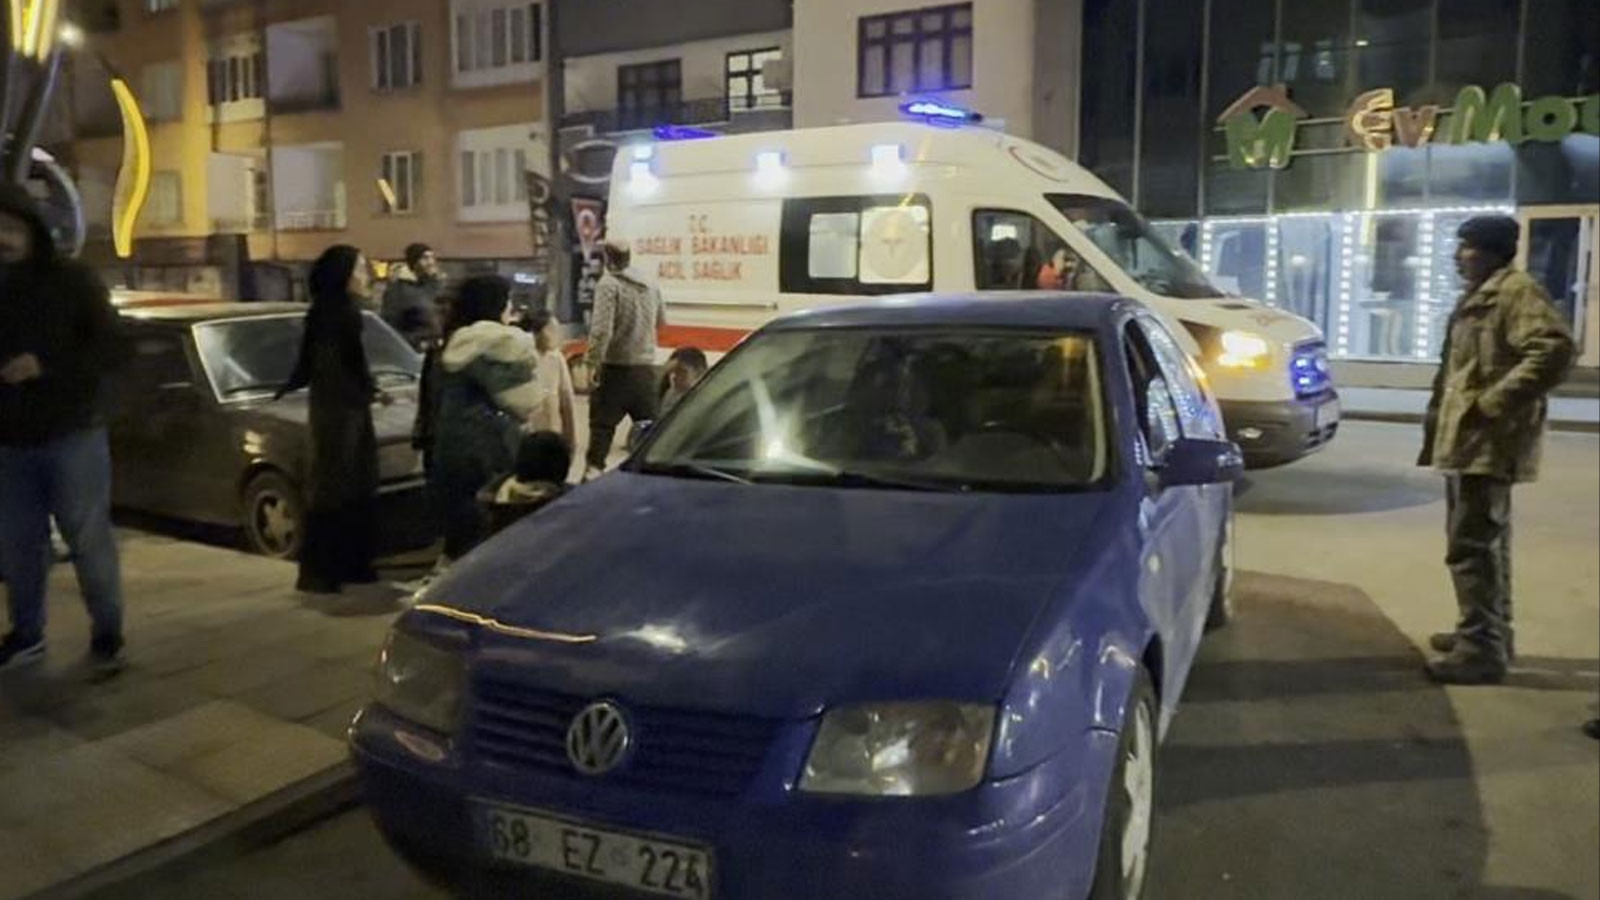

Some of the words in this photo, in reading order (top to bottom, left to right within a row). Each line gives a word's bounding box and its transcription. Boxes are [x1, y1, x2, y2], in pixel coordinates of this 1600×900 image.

[492, 816, 531, 858] 68
[561, 828, 604, 875] EZ
[637, 845, 704, 899] 224
